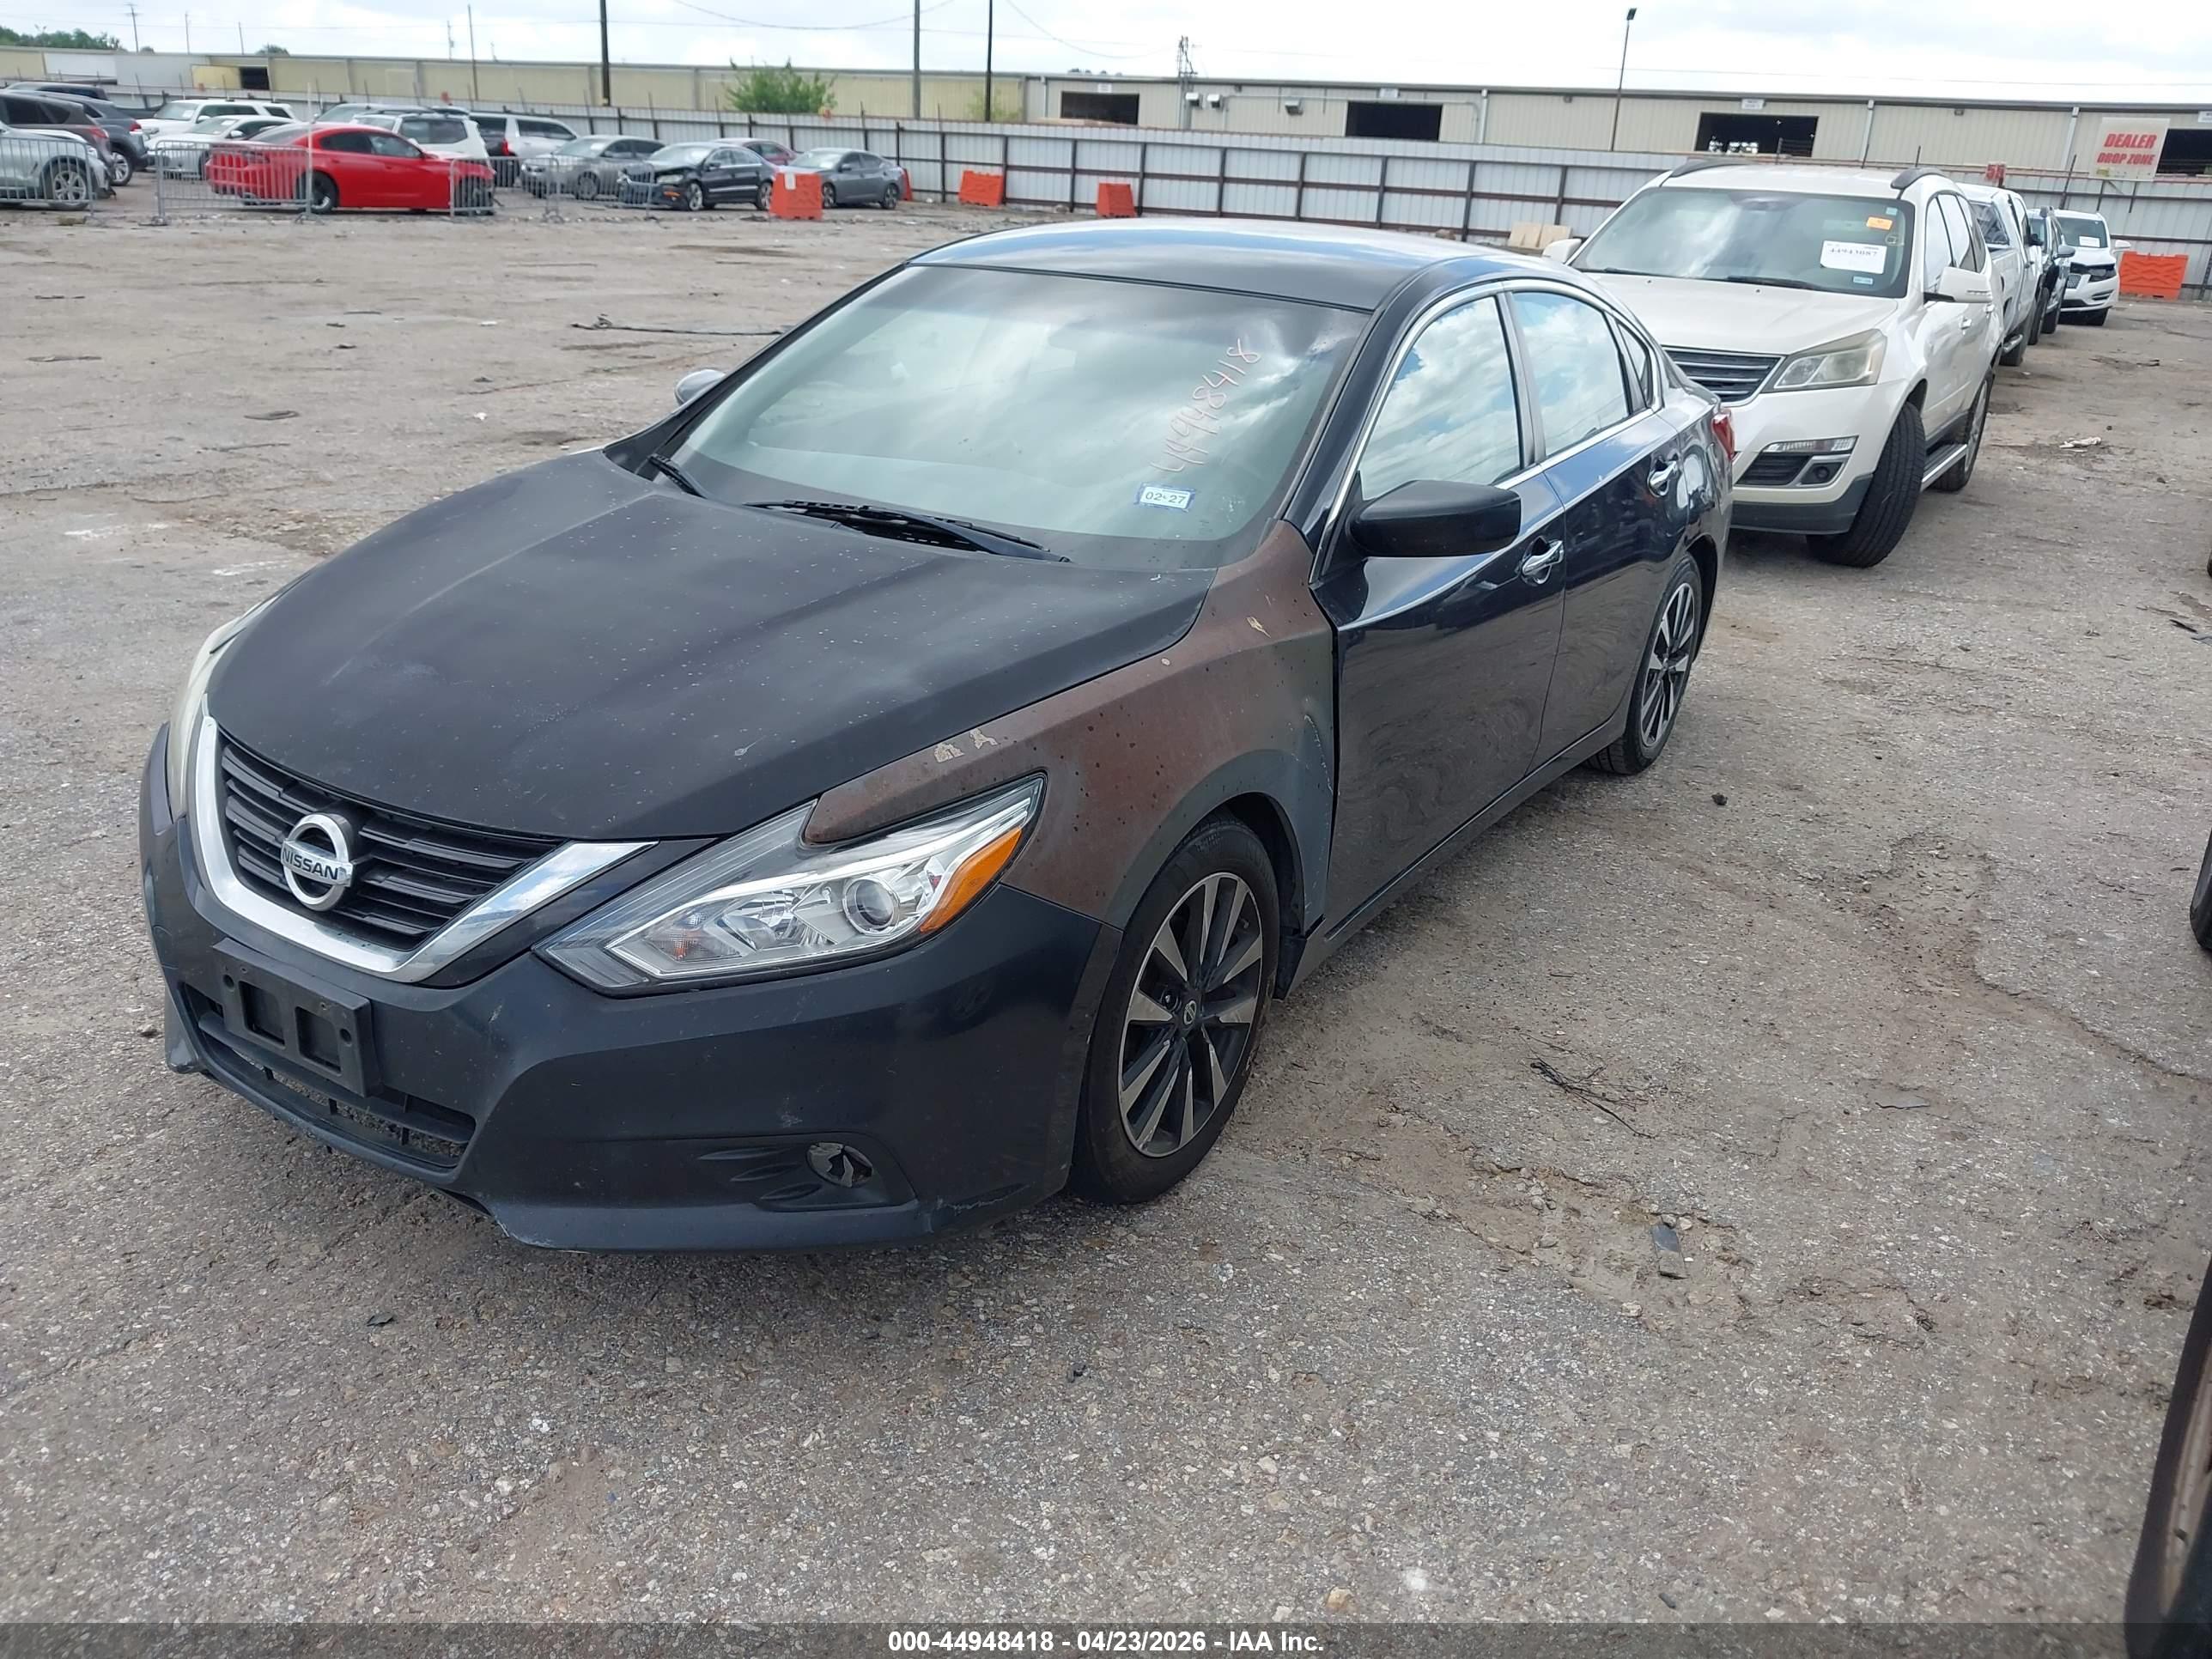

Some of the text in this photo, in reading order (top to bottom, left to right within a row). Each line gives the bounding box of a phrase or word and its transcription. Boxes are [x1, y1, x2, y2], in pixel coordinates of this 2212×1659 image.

[2104, 133, 2157, 149] DEALER
[2097, 152, 2155, 166] DROP ZONE
[1150, 337, 1261, 472] 44948418
[283, 848, 339, 880] NISSAN
